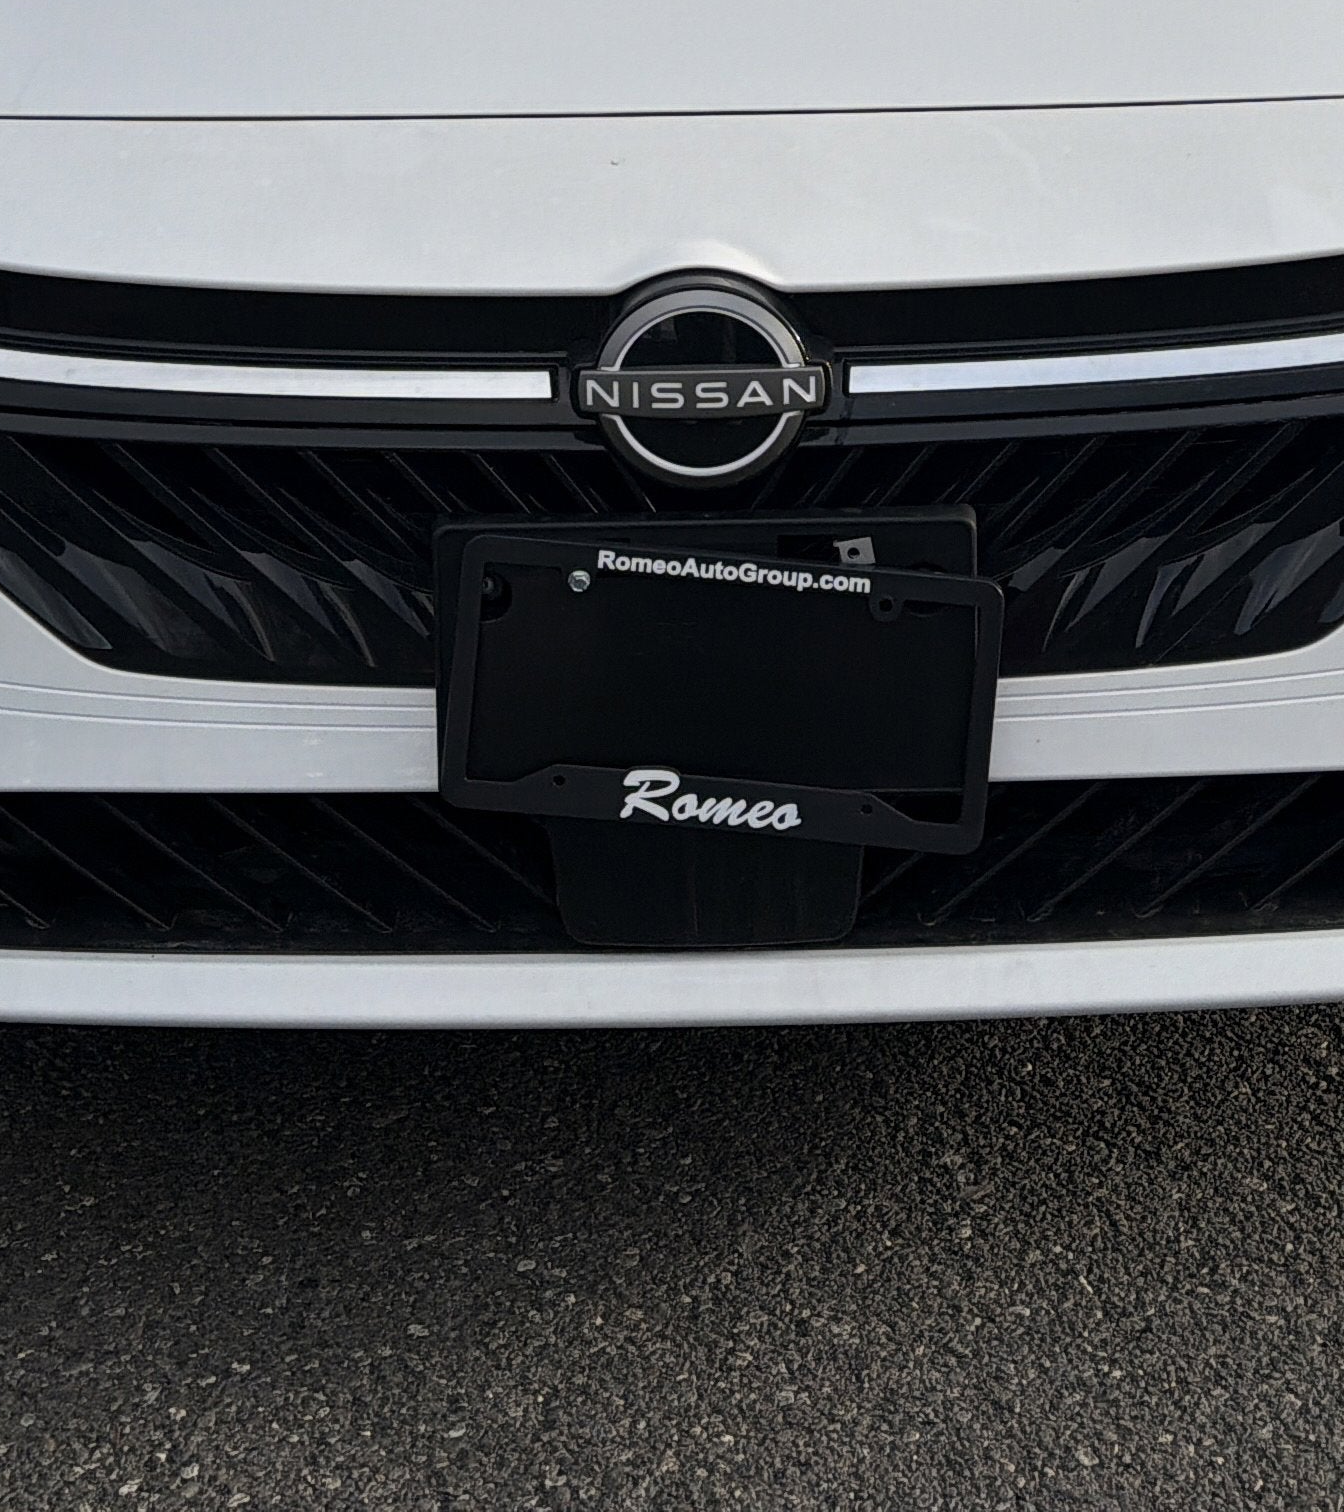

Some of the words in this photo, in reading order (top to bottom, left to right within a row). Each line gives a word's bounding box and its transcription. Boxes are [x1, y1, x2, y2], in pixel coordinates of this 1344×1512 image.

[585, 375, 817, 409] NISSAN
[597, 549, 871, 594] RomeoAutoGroup.com
[619, 769, 803, 831] Romeo
